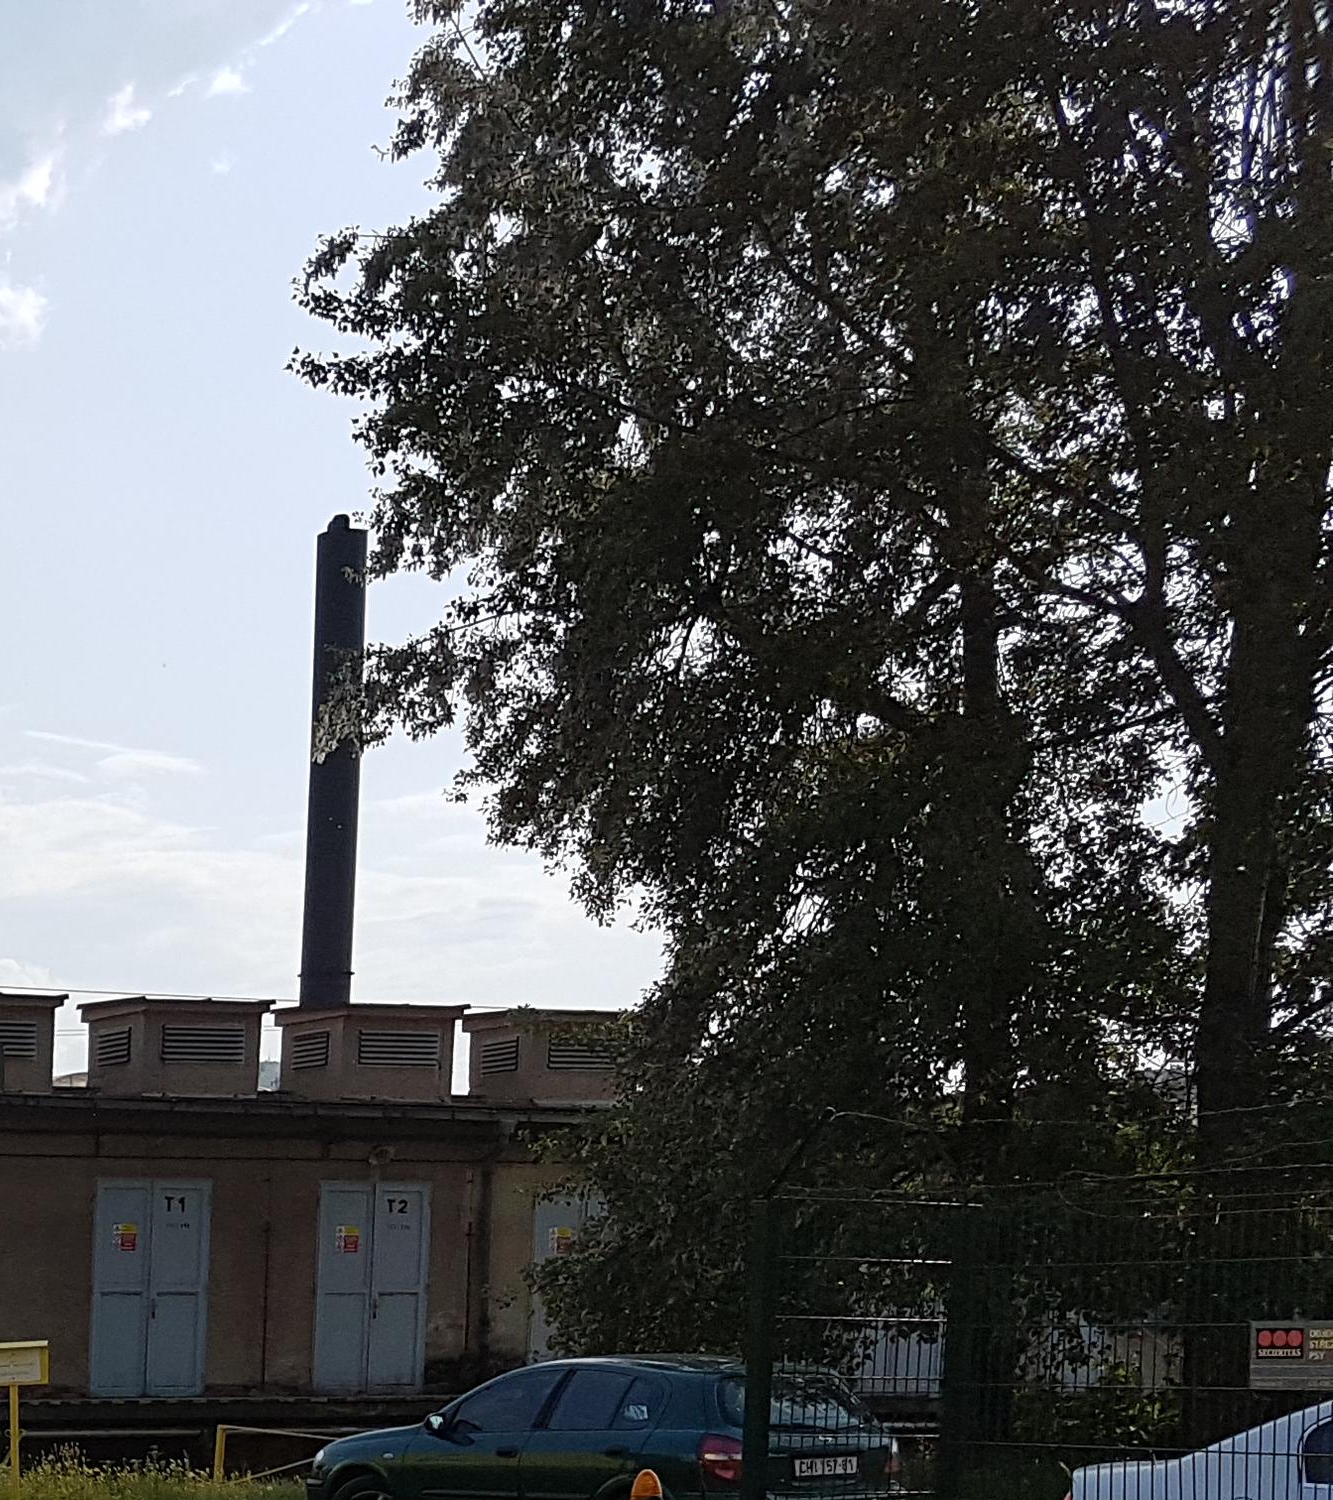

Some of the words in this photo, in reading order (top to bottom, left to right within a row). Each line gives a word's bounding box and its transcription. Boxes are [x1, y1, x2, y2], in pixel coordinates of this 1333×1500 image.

[165, 1196, 185, 1212] T1
[387, 1199, 408, 1214] T2
[1258, 1348, 1302, 1357] SECURITAS
